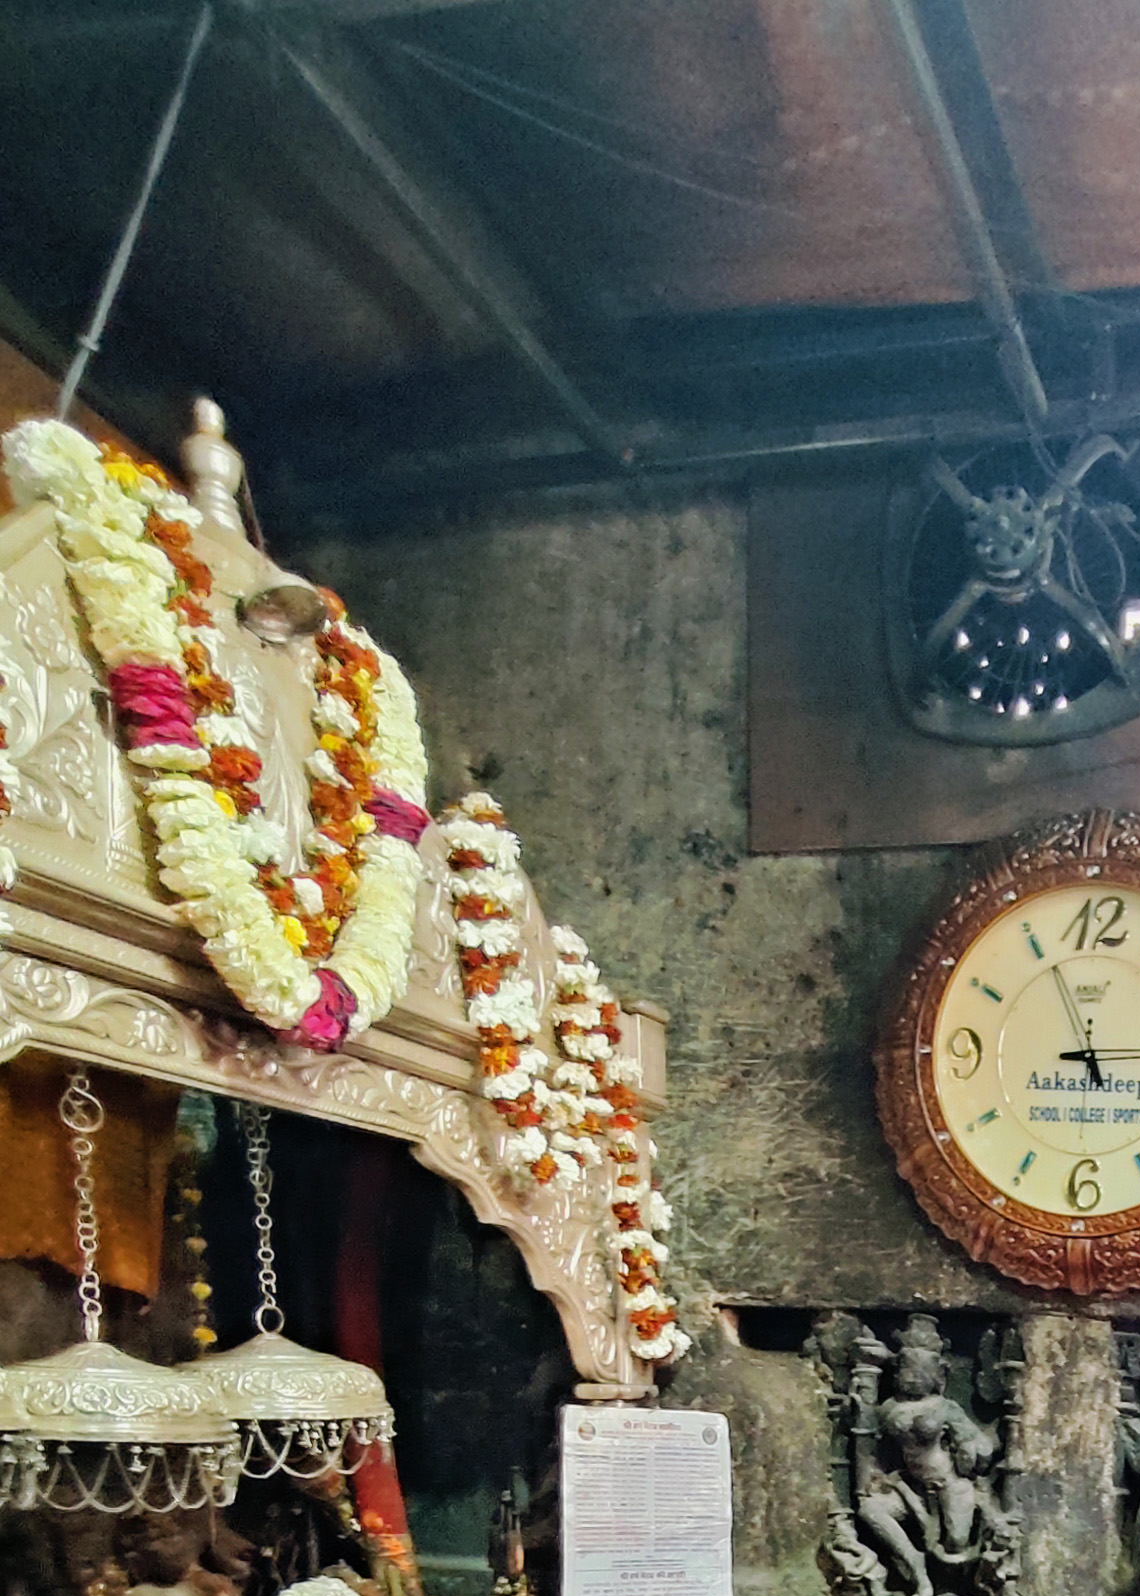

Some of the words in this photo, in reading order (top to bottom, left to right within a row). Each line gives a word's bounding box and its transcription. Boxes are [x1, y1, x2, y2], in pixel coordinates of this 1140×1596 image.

[1060, 895, 1130, 951] 12
[949, 1027, 983, 1081] 9
[1029, 1106, 1061, 1122] SCHOOL
[1068, 1107, 1106, 1123] COLLEGE
[1067, 1158, 1102, 1213] 6
